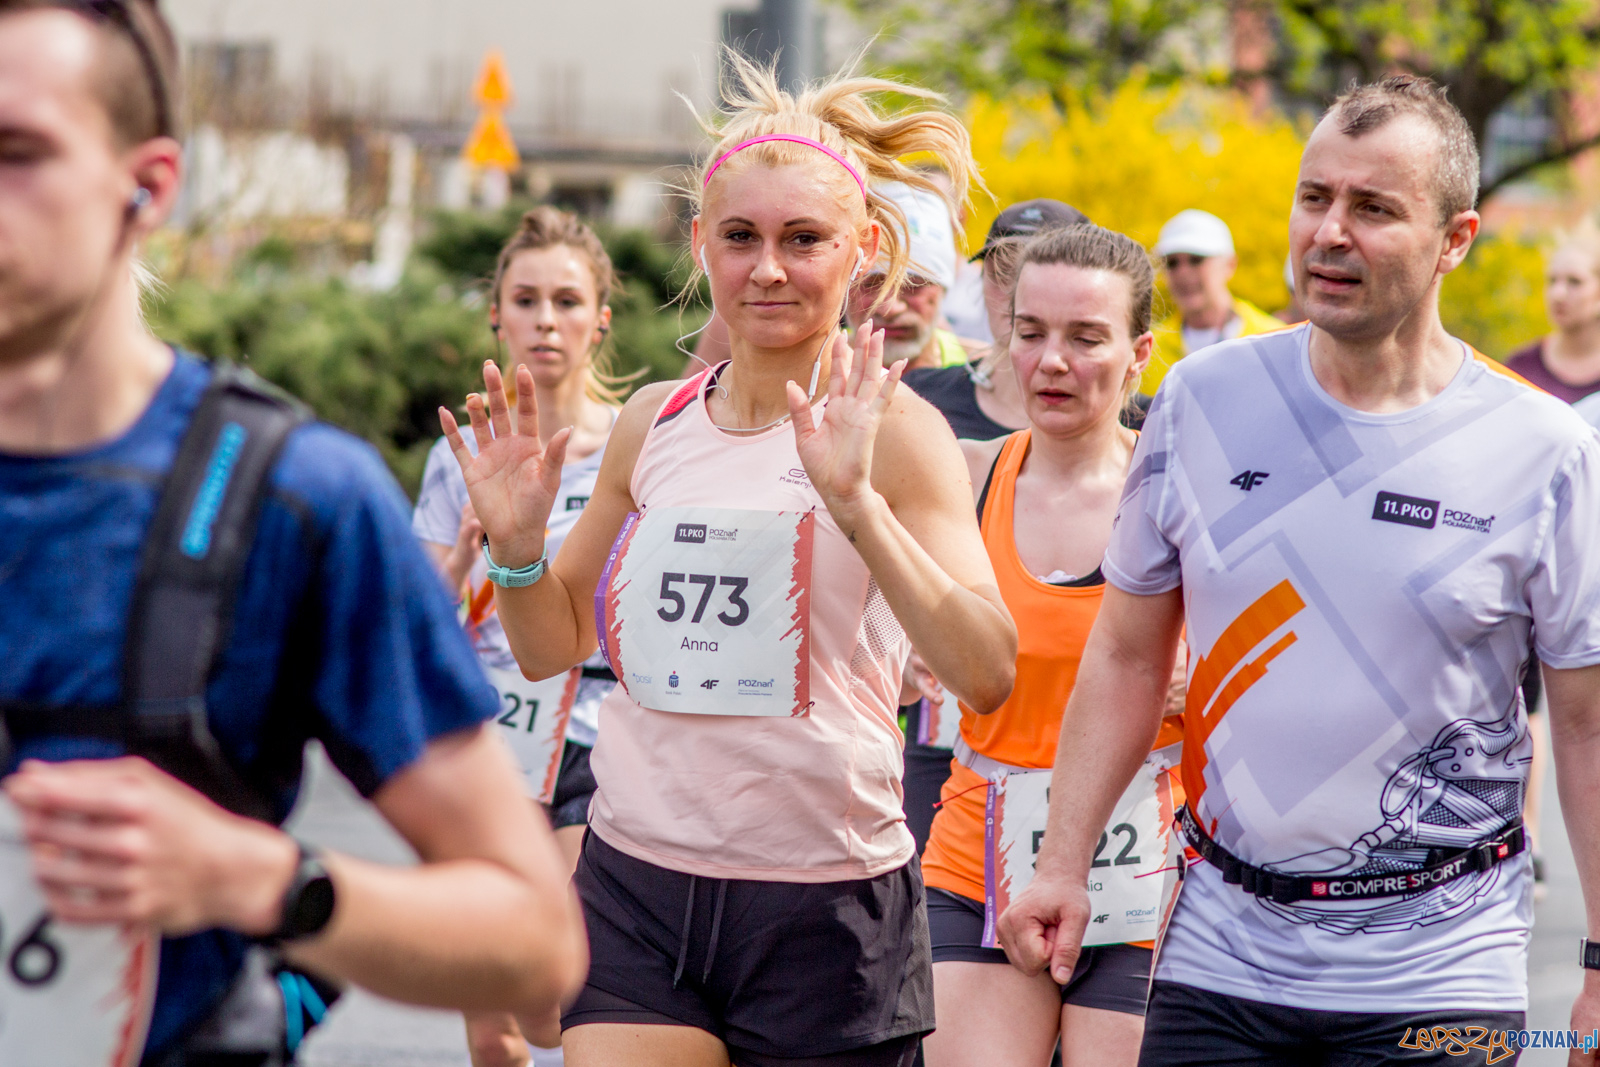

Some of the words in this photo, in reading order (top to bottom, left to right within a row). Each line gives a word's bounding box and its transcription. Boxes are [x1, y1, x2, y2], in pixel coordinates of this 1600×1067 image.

[1230, 469, 1270, 491] 4F
[1382, 500, 1399, 515] 11.
[1400, 503, 1434, 521] PKO
[687, 529, 704, 539] PKO
[656, 572, 750, 627] 573
[680, 636, 719, 652] Anna
[700, 679, 720, 690] 4F
[1093, 914, 1110, 924] 4F
